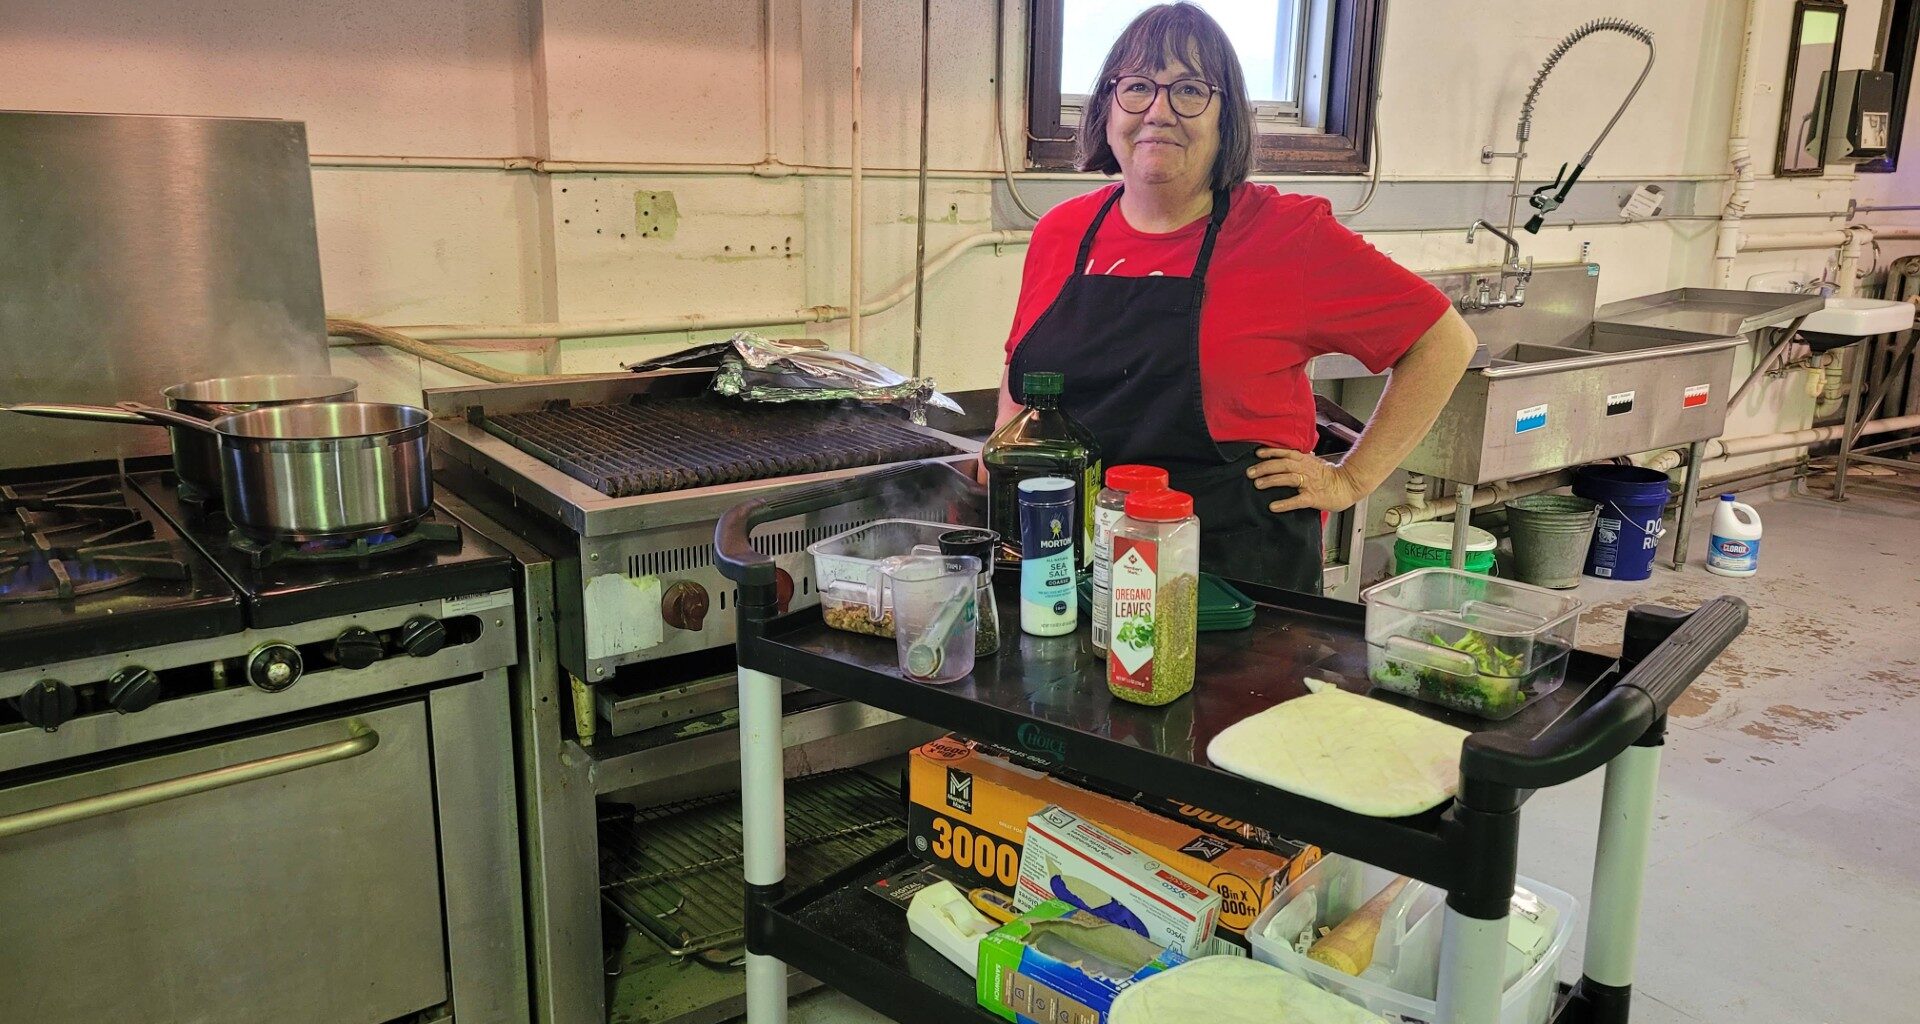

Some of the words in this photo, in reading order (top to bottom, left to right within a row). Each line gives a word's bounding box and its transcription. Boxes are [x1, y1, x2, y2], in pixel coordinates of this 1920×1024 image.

[1645, 517, 1662, 535] DO
[1040, 536, 1072, 549] MORTON
[1722, 543, 1747, 554] CLOROX
[1404, 543, 1441, 560] GREASE
[1048, 568, 1068, 578] SALT
[1050, 562, 1067, 571] SEA
[1115, 588, 1152, 600] OREGANO
[1115, 602, 1152, 618] LEAVES
[1026, 755, 1051, 766] FOOD
[948, 792, 971, 808] Member's
[932, 817, 1019, 887] 3000
[890, 882, 922, 897] DIGITAL
[1162, 881, 1188, 900] Sysco
[1221, 899, 1256, 917] 000ft
[1166, 926, 1187, 944] Sysco
